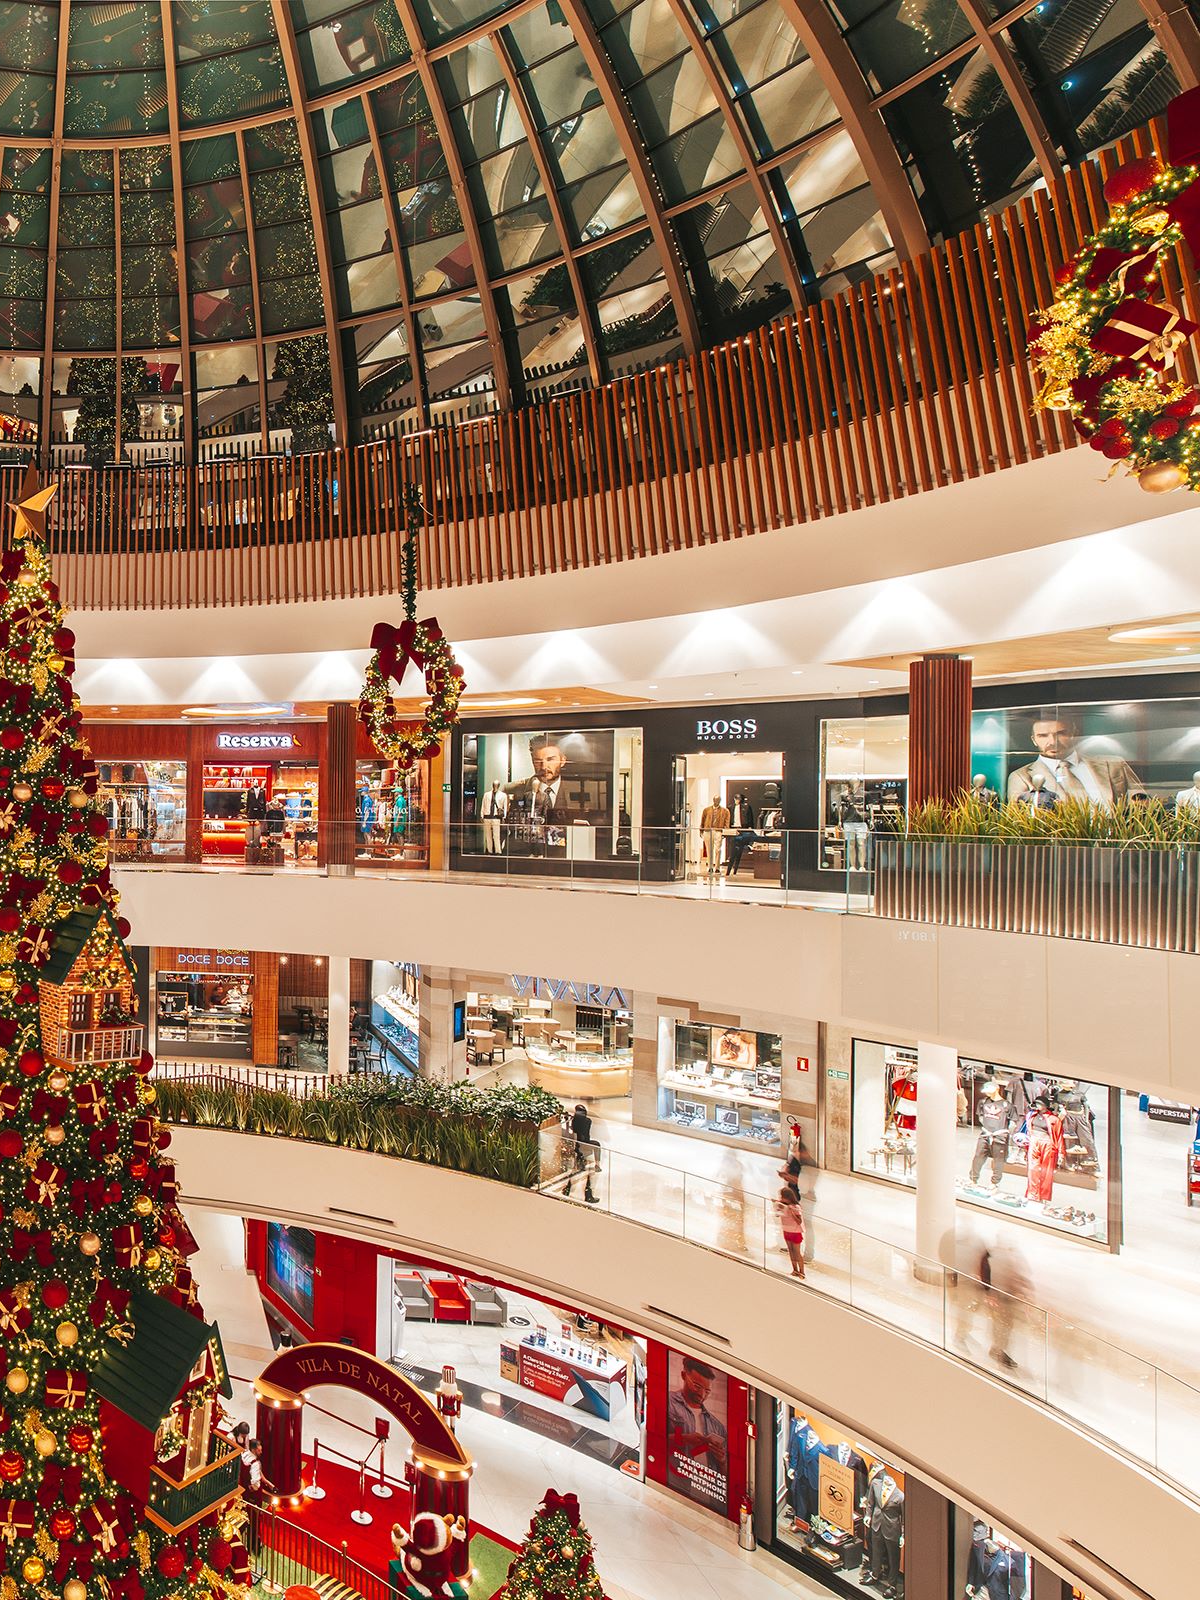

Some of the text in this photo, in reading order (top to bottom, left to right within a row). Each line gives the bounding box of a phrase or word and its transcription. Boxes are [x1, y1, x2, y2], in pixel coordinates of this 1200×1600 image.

[696, 719, 757, 735] BOSS
[218, 734, 293, 748] Reserva
[178, 954, 249, 966] DOCE DOCE
[511, 974, 629, 1009] VIVARA
[1149, 1107, 1190, 1119] SUPERSTAR
[296, 1358, 423, 1426] VILA DE NATAL
[673, 1451, 727, 1482] SUPEROFERTAS
[679, 1460, 727, 1490] PARA SAIR DE
[677, 1466, 727, 1497] SMARTPHONE
[690, 1481, 727, 1504] NOVINHO.
